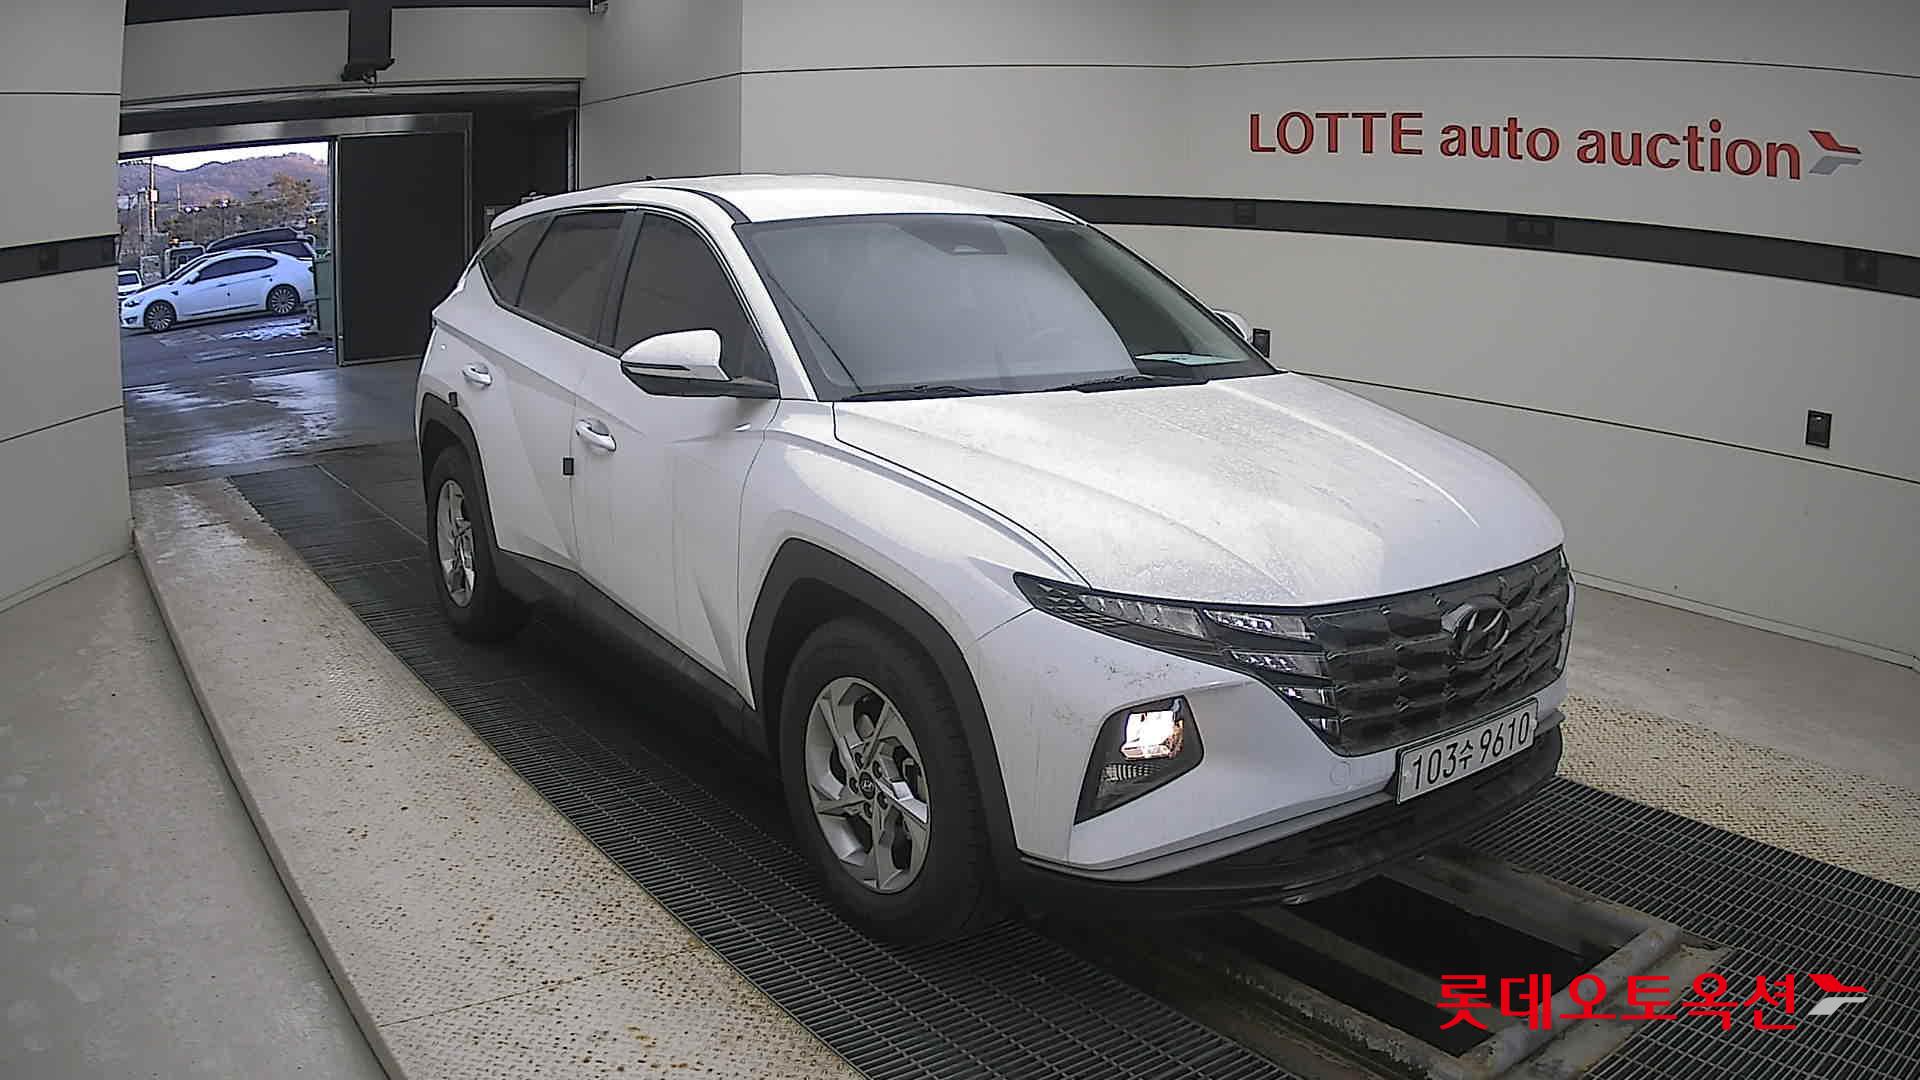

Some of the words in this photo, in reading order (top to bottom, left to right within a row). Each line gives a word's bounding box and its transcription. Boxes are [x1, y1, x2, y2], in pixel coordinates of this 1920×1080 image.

[1249, 112, 1424, 155] LOTTE
[1439, 117, 1560, 162] auto
[1576, 118, 1802, 181] auction
